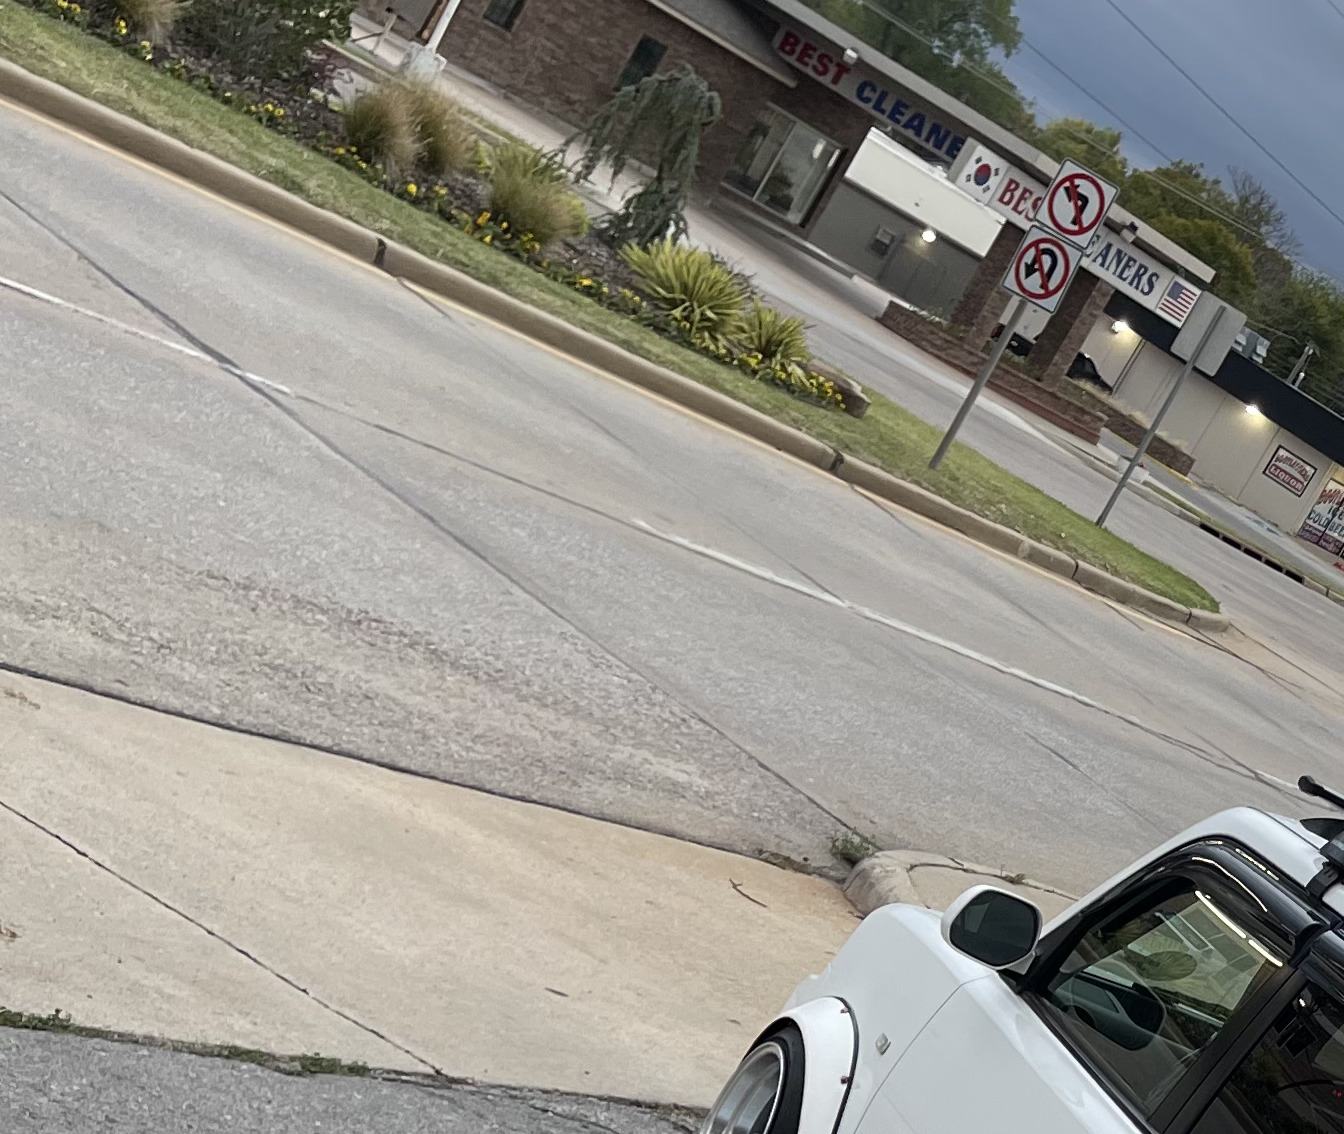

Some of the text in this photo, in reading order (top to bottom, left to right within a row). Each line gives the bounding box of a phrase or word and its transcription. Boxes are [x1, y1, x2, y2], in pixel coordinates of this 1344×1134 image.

[777, 31, 966, 160] BEST CLEANE
[998, 177, 1043, 223] BES
[1268, 464, 1306, 493] LIQUOR
